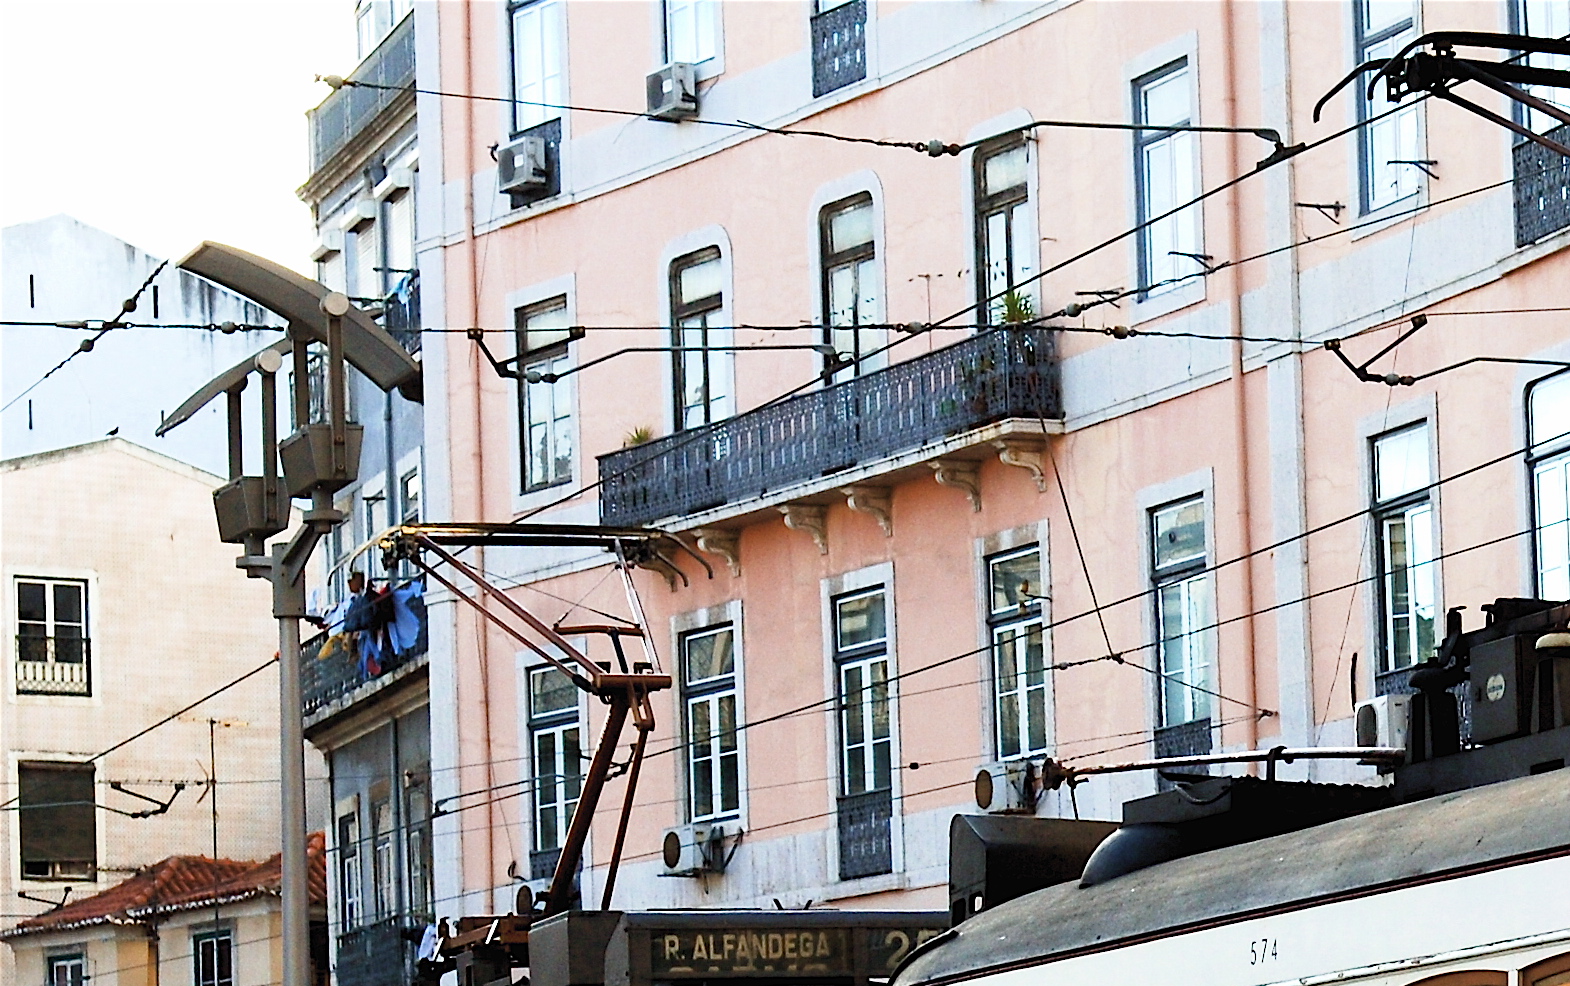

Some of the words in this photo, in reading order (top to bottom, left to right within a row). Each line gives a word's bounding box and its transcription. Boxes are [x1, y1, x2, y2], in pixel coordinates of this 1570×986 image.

[663, 934, 685, 961] R.
[691, 931, 831, 961] ALFANDEGA
[1250, 938, 1278, 966] 574
